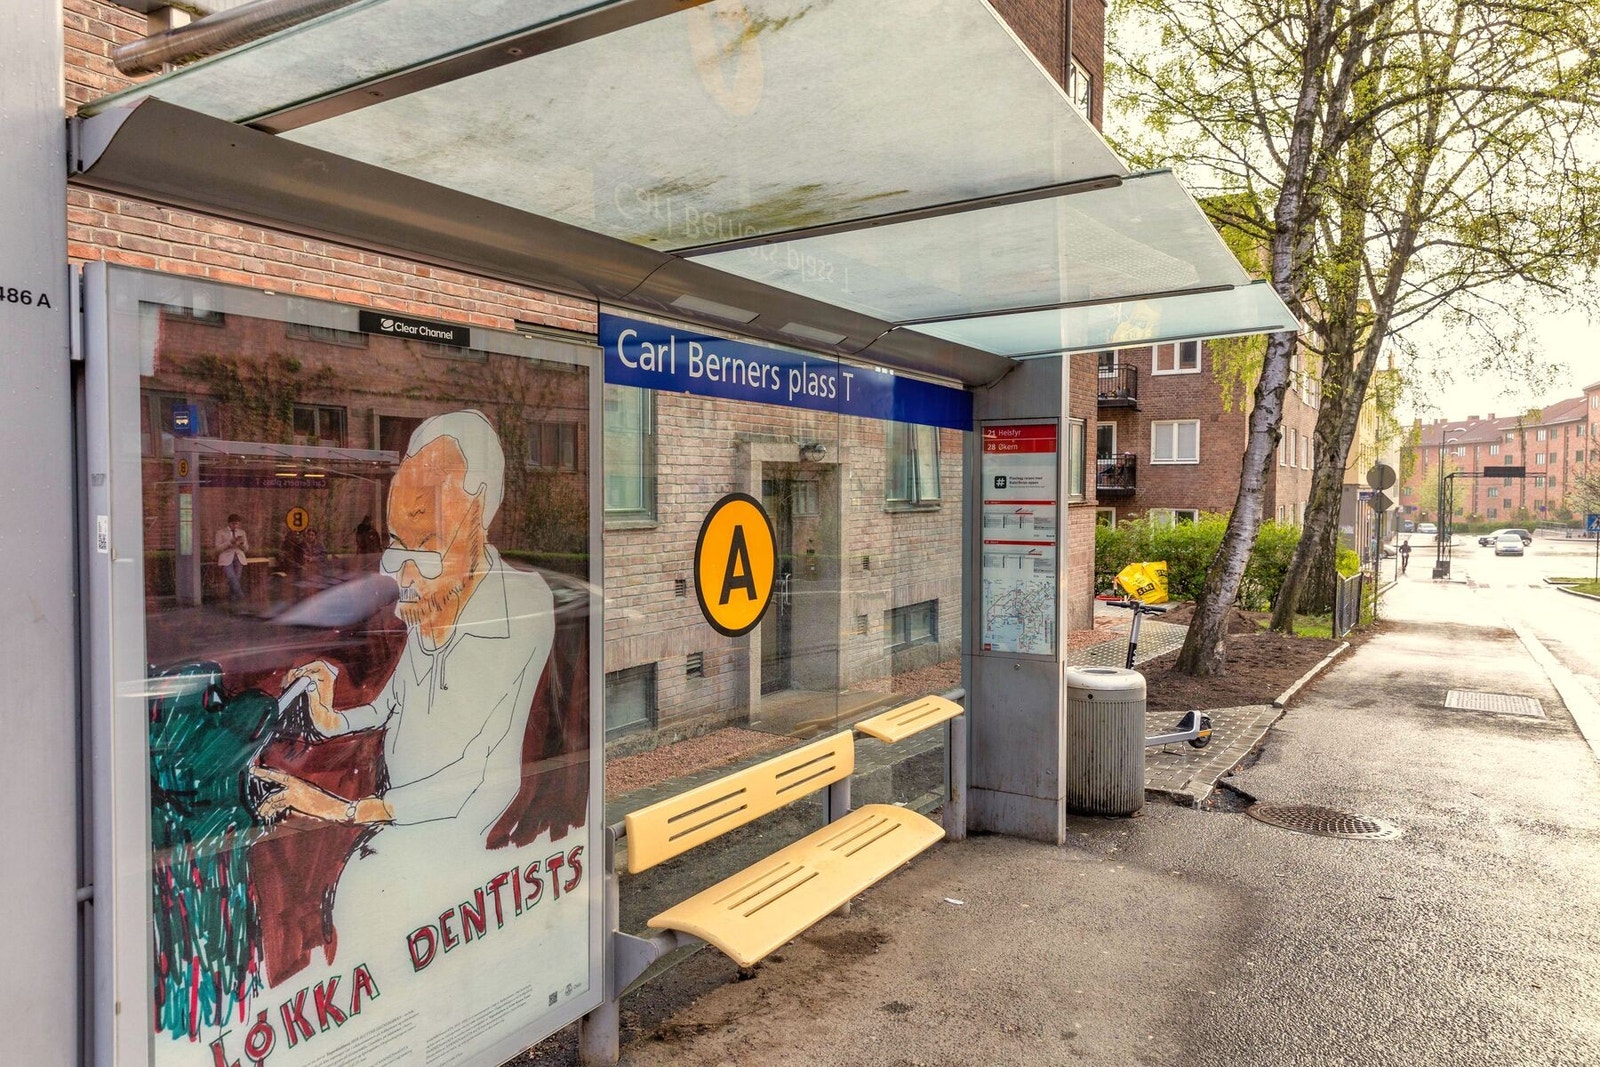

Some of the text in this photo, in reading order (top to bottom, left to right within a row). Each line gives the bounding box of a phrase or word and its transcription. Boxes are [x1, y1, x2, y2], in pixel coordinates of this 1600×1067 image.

[36, 293, 51, 309] A
[394, 322, 453, 340] Clear Channel
[617, 328, 854, 401] Carl Berners plass T
[998, 429, 1022, 438] Helsfyr
[987, 443, 1018, 451] 28 Økern
[719, 524, 758, 606] A
[406, 845, 585, 972] DENTISTS
